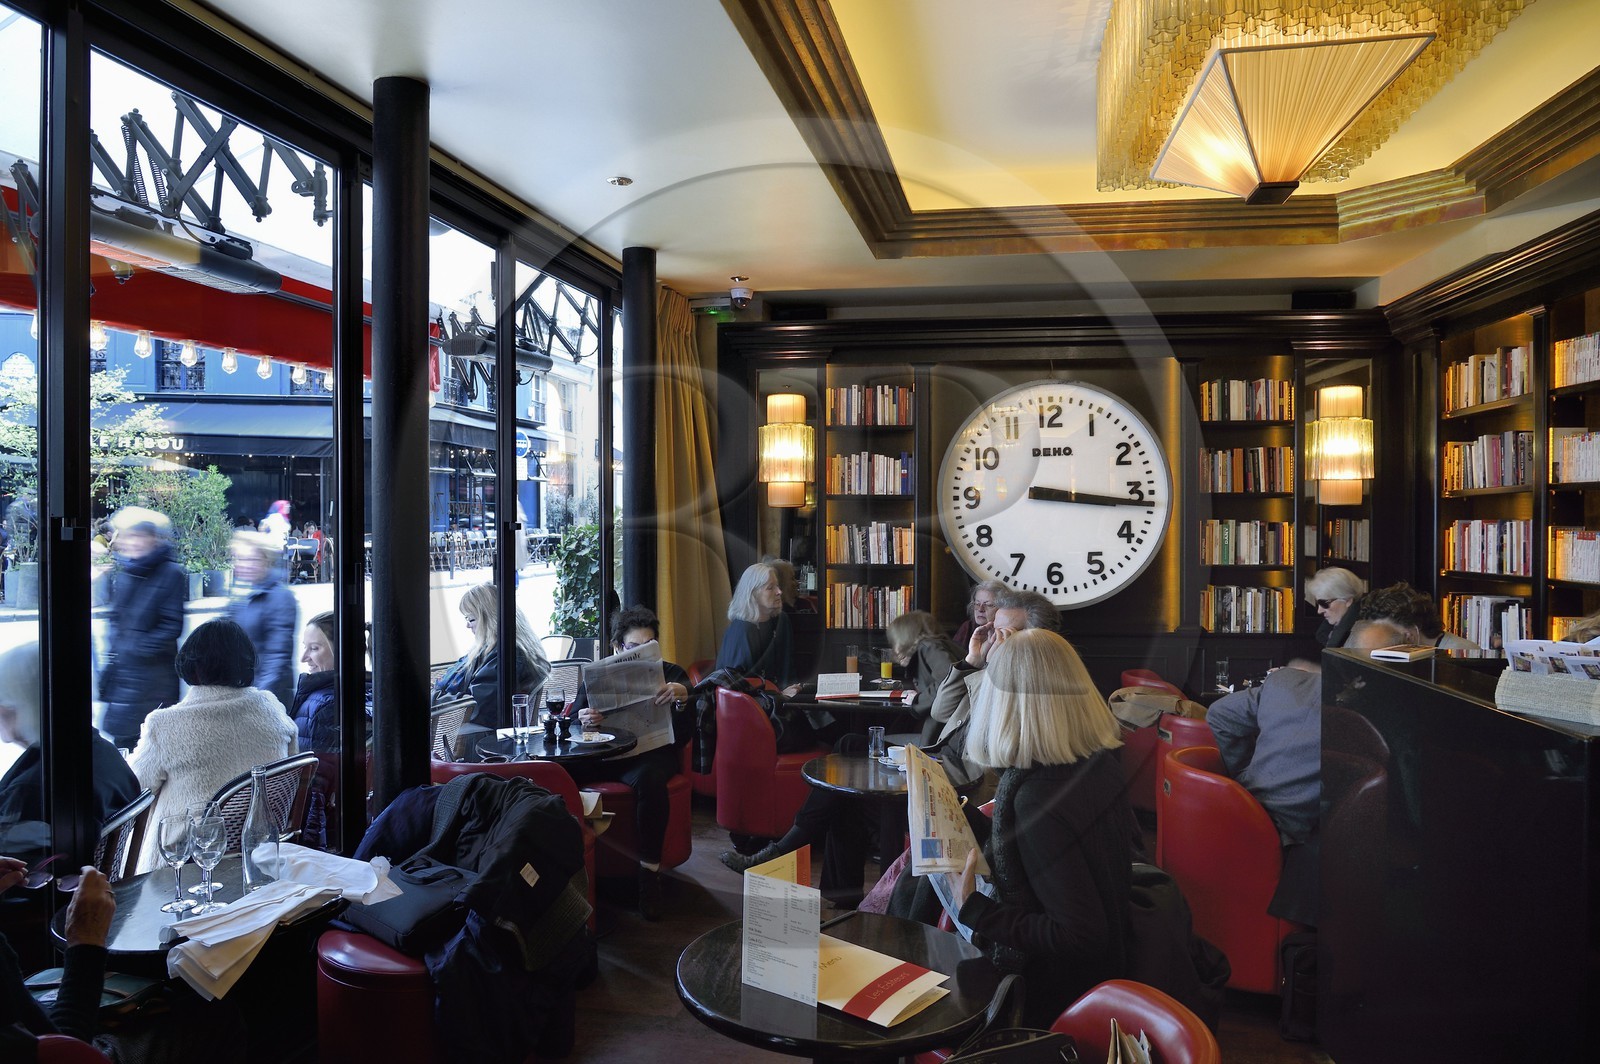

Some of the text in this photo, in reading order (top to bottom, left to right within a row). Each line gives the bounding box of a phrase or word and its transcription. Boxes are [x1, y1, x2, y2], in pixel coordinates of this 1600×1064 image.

[1005, 416, 1019, 440] 11
[1038, 404, 1063, 429] 12
[1089, 413, 1095, 437] 1
[118, 434, 184, 451] HIBOU
[1115, 442, 1132, 465] 2
[975, 446, 1000, 471] 10
[963, 486, 981, 509] 9
[1126, 481, 1145, 501] 3
[976, 525, 993, 547] 8
[1117, 520, 1135, 544] 4
[1010, 553, 1026, 577] 7
[1046, 562, 1064, 585] 6
[1086, 551, 1105, 575] 5
